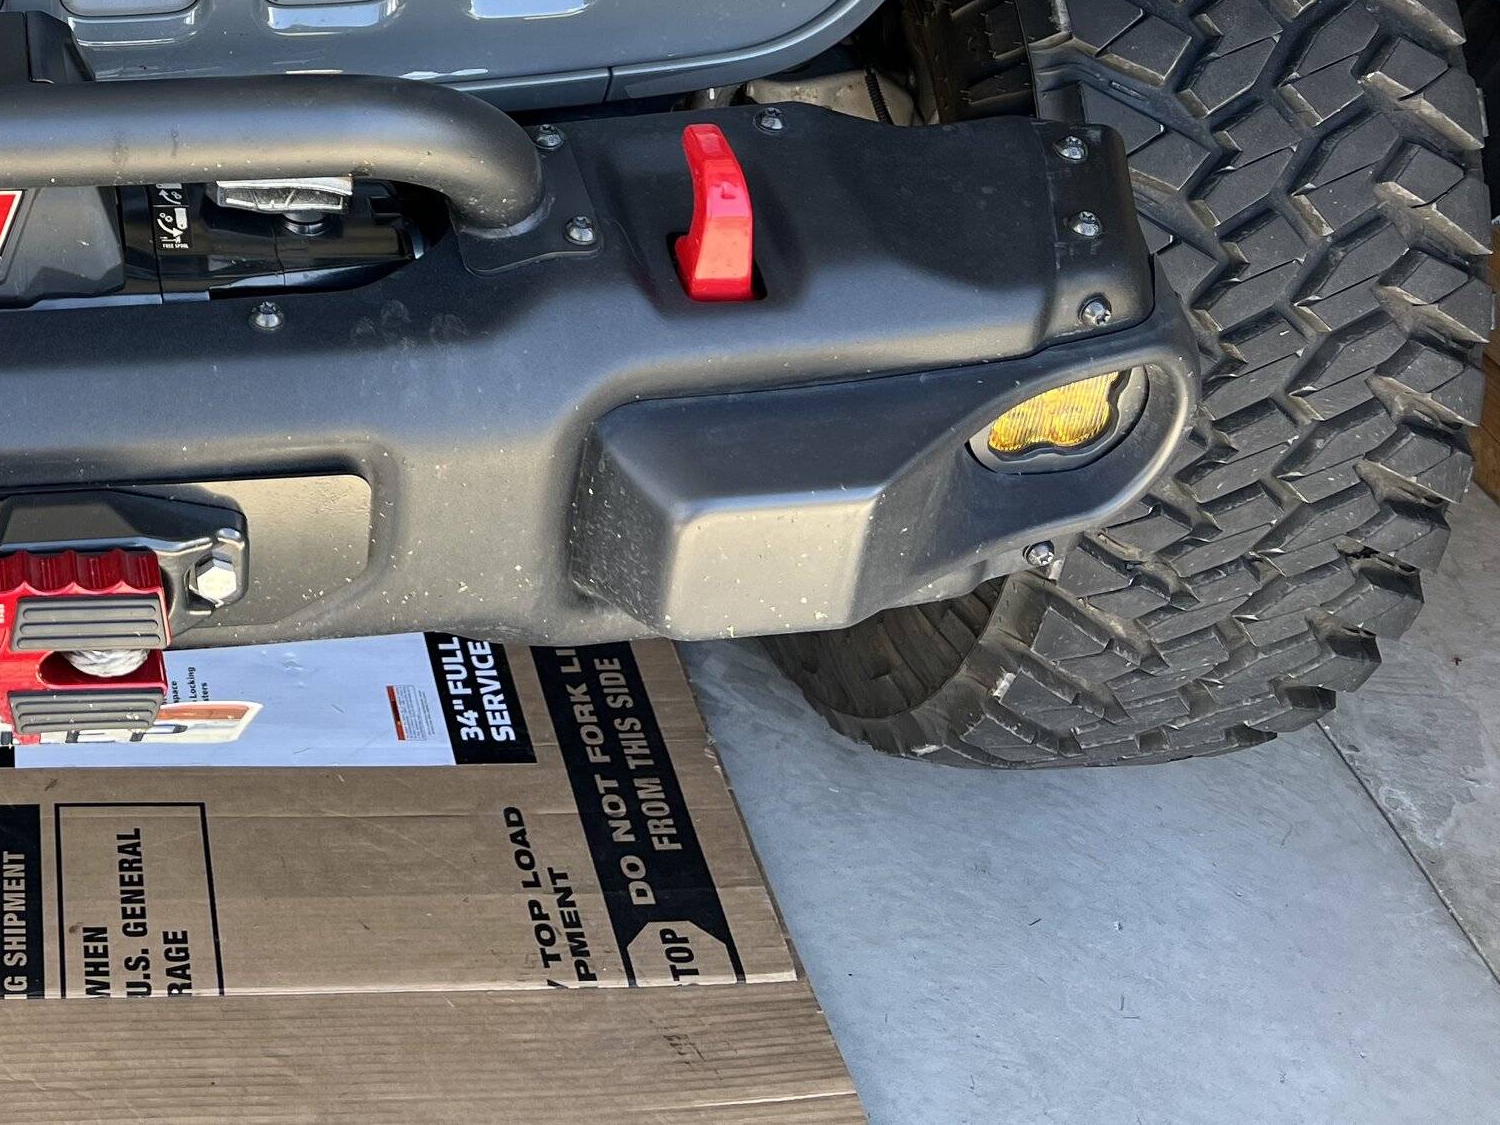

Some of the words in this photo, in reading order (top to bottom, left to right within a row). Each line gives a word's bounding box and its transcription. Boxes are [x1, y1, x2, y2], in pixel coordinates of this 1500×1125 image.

[187, 666, 197, 700] Locking
[438, 636, 472, 695] FULL
[467, 640, 516, 742] SERVICE
[594, 657, 634, 709] SIDE
[452, 698, 485, 742] 34"
[566, 683, 611, 764] FORK
[614, 717, 655, 770] THIS
[594, 774, 636, 843] NOT
[633, 777, 683, 851] FROM
[503, 806, 542, 889] LOAD
[619, 855, 656, 906] DO
[3, 851, 28, 967] SHIPMENT
[116, 828, 148, 938] GENERAL
[528, 899, 562, 968] TOP
[547, 866, 598, 982] PMENT
[659, 928, 700, 982] TOP
[82, 926, 111, 998] WHEN
[124, 948, 152, 998] U.S.
[162, 930, 192, 997] RAGE
